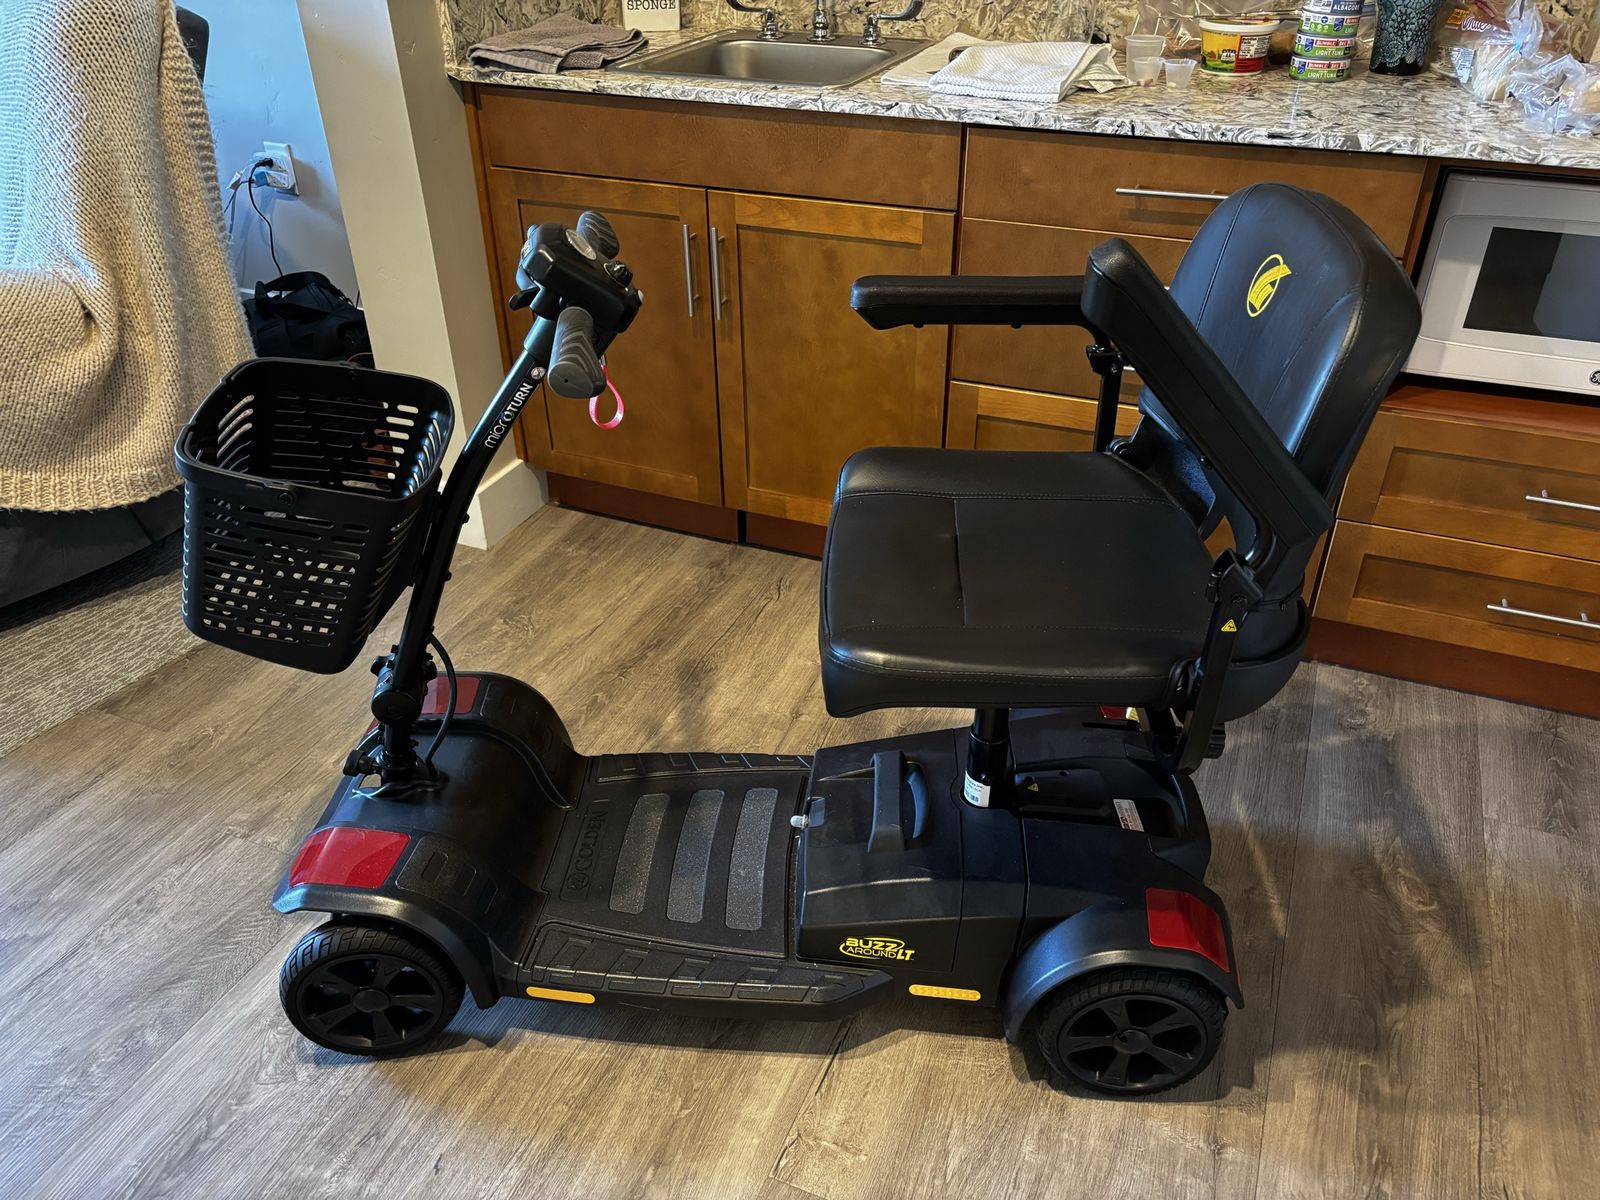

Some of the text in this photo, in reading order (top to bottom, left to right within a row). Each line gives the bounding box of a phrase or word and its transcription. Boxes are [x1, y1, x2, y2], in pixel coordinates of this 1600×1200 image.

[627, 0, 676, 10] SPONGE
[575, 810, 609, 872] GOLDEN
[846, 938, 898, 952] BUZZ
[846, 946, 915, 960] AROUND LT
